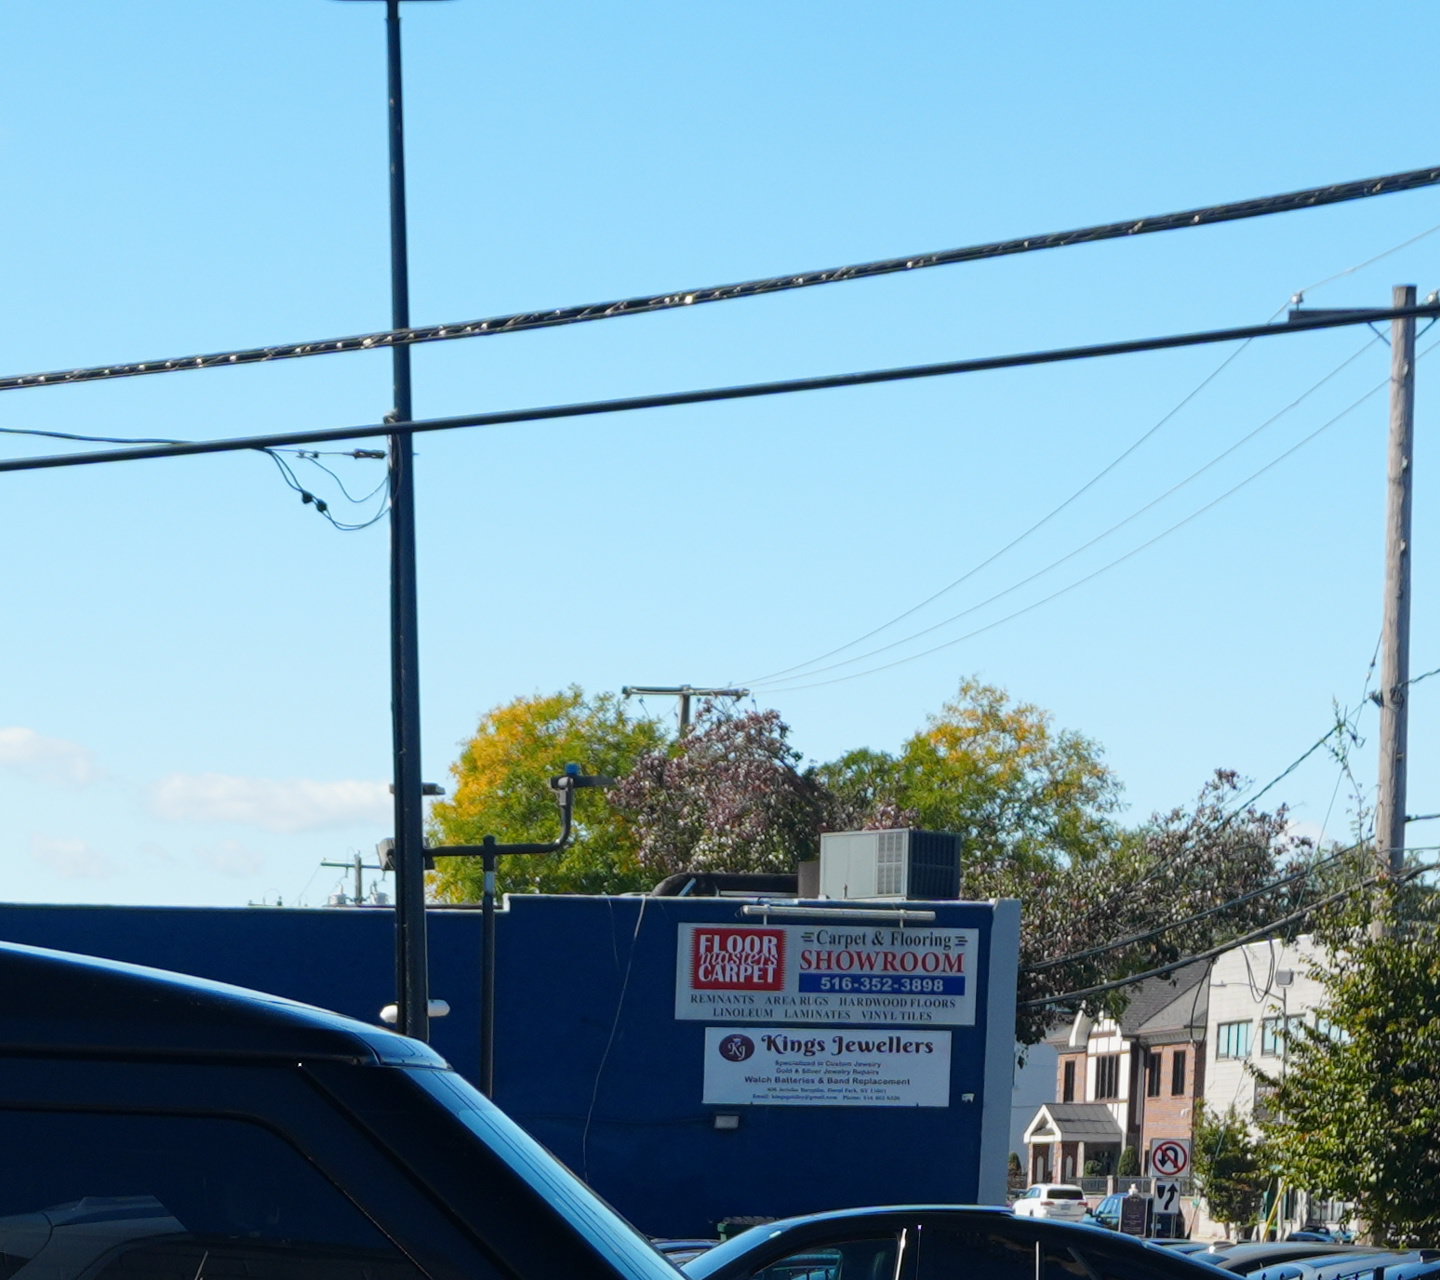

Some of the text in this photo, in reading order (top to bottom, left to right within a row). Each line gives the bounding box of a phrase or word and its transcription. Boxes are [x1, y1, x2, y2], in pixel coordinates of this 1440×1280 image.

[699, 935, 778, 957] FLOOR
[816, 930, 952, 951] Carpet & Flooring
[699, 950, 778, 968] masters
[800, 950, 965, 973] SHOWROOM
[698, 963, 776, 983] CARPET
[820, 976, 944, 993] 516-352-3898
[690, 994, 956, 1009] REMNANTS AREA RUGS HARDWOOD FLOORS
[713, 1008, 932, 1020] LINOLEUM LAMINATES VINYL TILES
[761, 1034, 934, 1057] Kings Jewellers
[852, 1078, 910, 1086] Replacement
